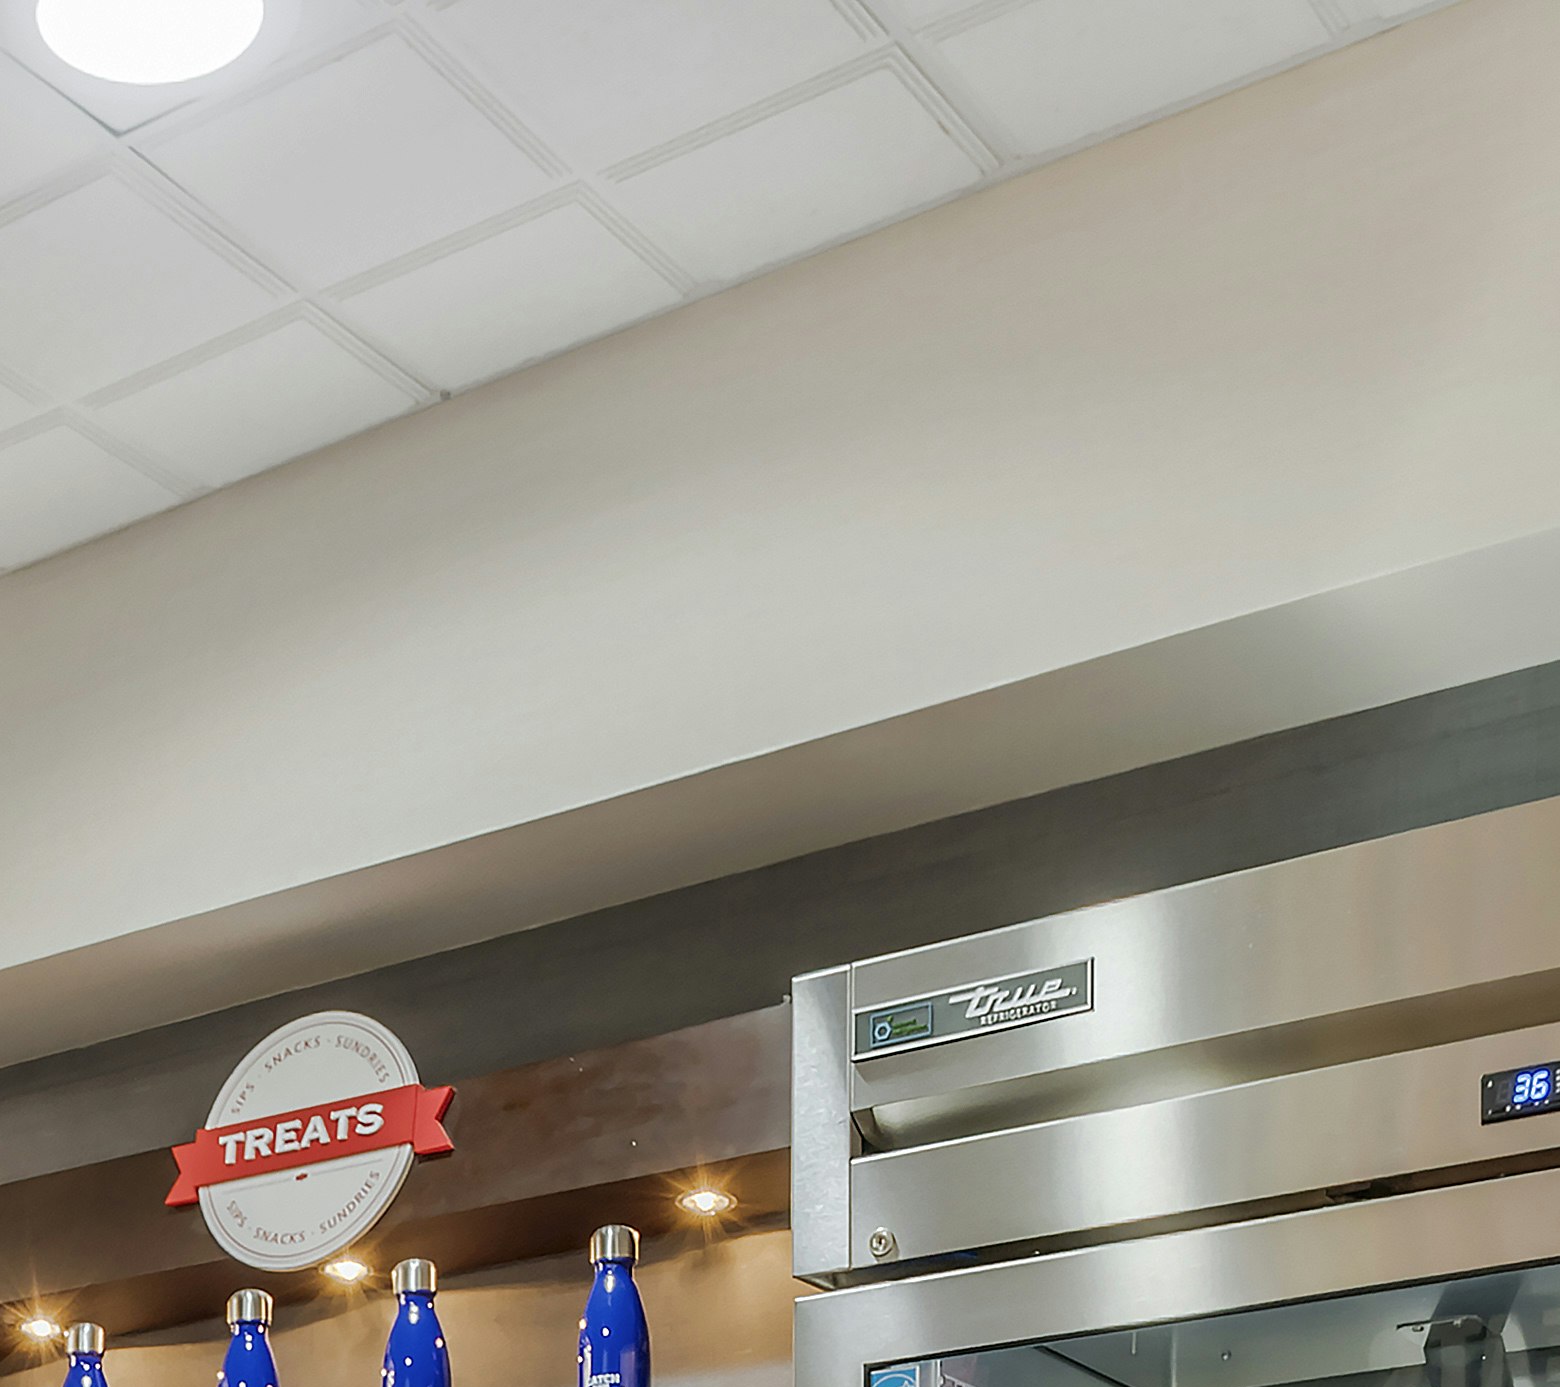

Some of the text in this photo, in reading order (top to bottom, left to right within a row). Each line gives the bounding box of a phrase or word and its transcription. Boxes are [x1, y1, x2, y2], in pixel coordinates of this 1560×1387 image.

[980, 1001, 1057, 1025] REFRIGERATOR
[265, 1036, 321, 1072] SNACKS
[335, 1035, 390, 1084] SUNDRIES
[1514, 1070, 1550, 1103] 36
[218, 1103, 384, 1165] TREATS
[254, 1226, 305, 1246] SNACKS
[319, 1171, 380, 1234] SUNDRIES
